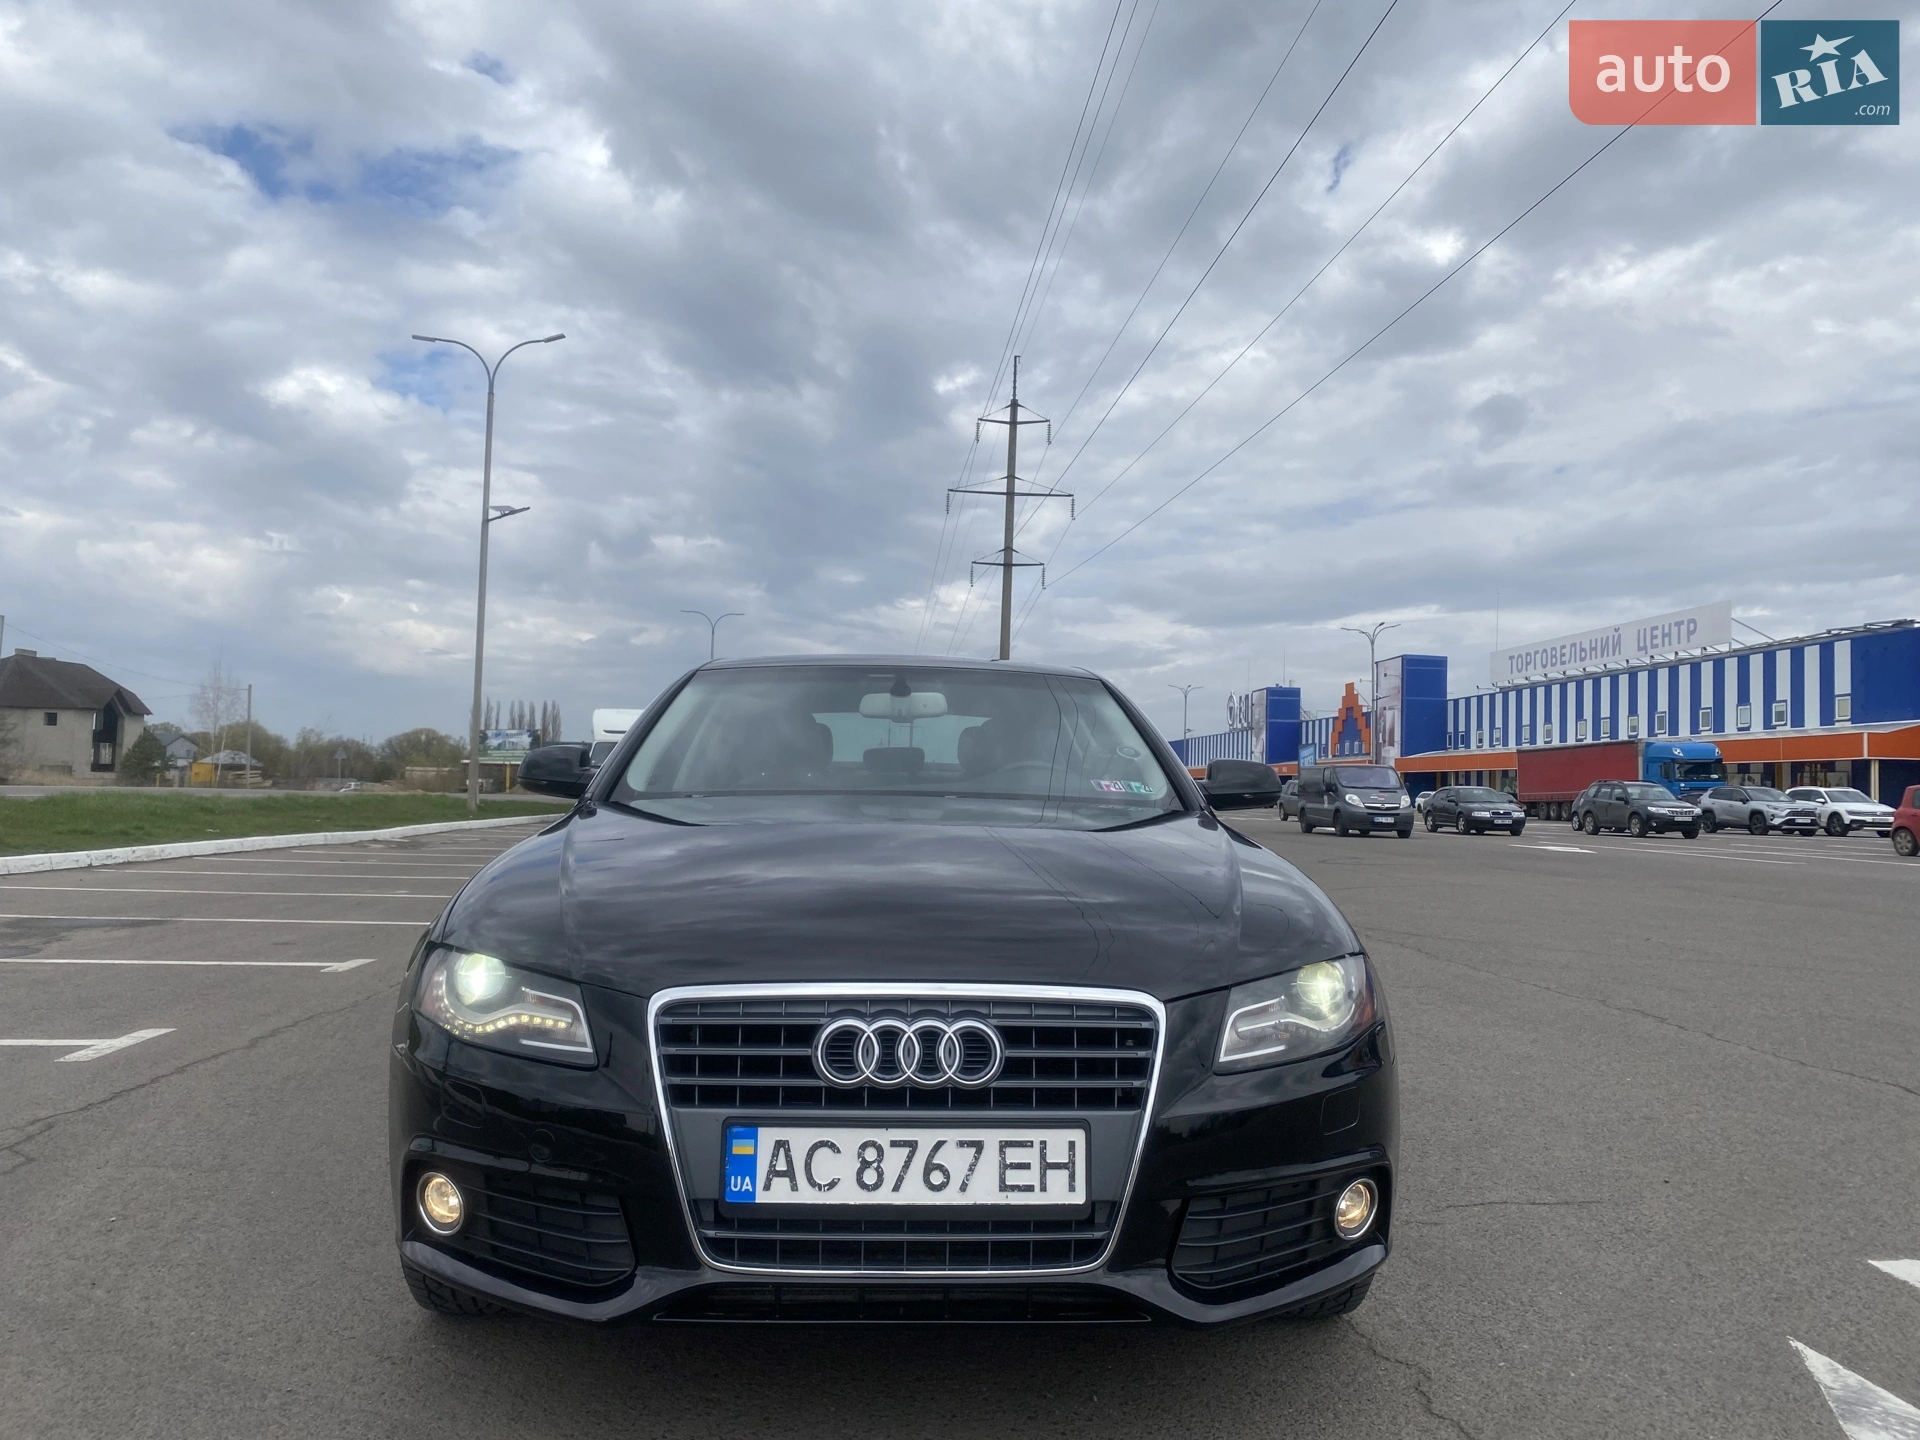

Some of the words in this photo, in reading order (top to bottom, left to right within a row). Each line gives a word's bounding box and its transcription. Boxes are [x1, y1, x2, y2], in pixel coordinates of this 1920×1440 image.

[1508, 627, 1622, 675] ТОРГОВЕЛЬНИЙ
[1637, 617, 1698, 652] ЦЕНТР
[730, 1175, 753, 1193] UA
[762, 1139, 841, 1193] AC
[855, 1139, 985, 1193] 8767
[998, 1139, 1076, 1193] EH
